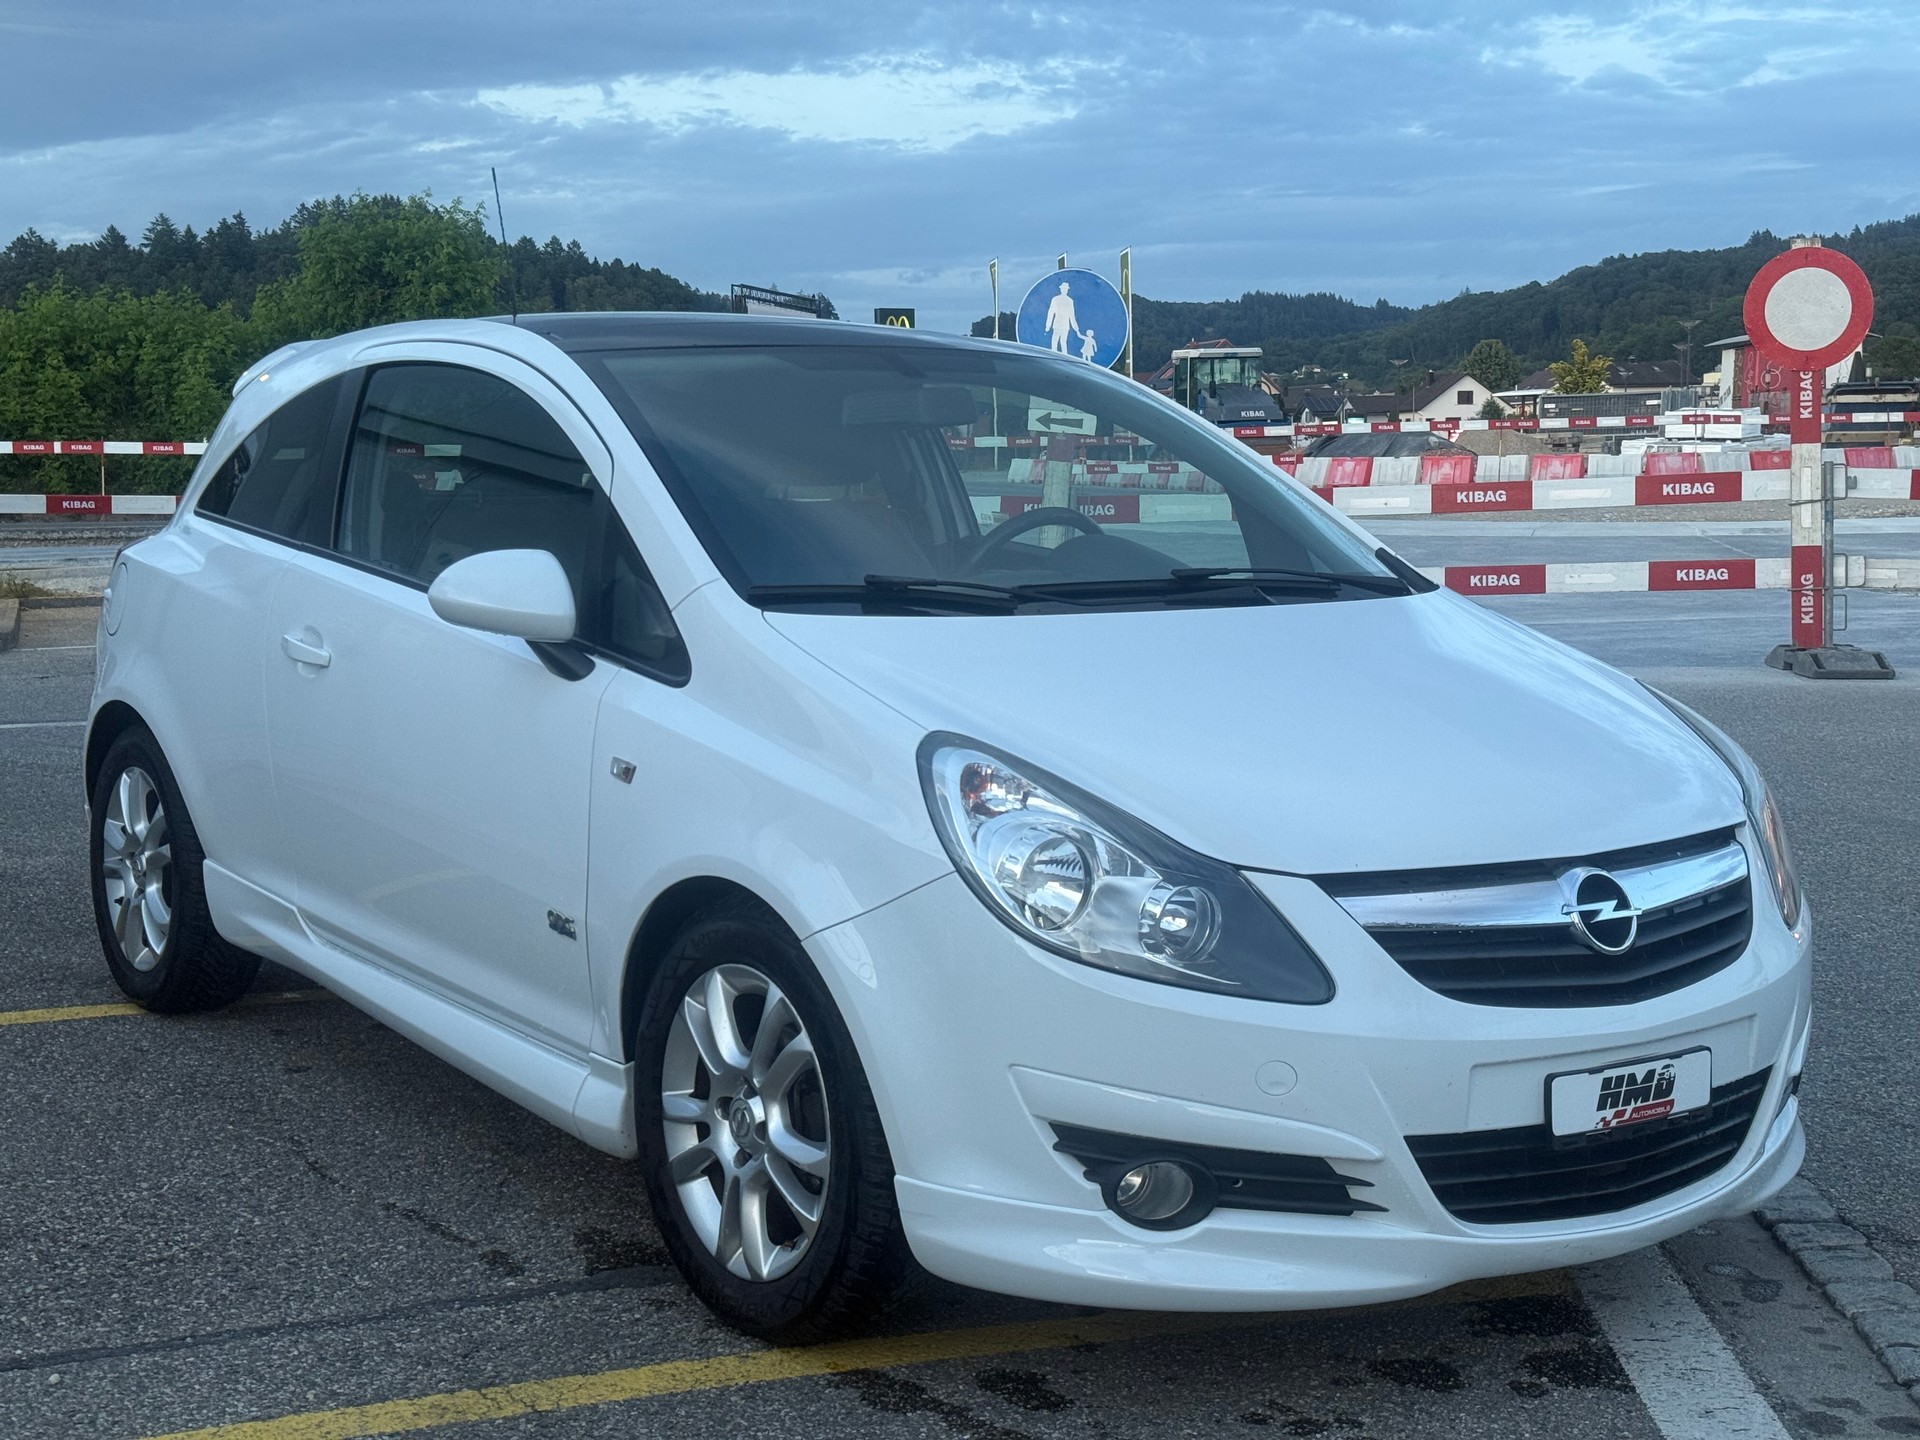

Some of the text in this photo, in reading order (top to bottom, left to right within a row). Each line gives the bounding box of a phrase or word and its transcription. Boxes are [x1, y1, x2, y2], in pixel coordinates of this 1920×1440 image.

[1799, 370, 1812, 418] KIBAG
[1241, 410, 1265, 418] KIBAG
[1662, 482, 1715, 496] KIBAG
[1456, 490, 1507, 504] KIBAG
[62, 500, 96, 510] KIBAG
[1470, 574, 1520, 587] KIBAG
[1677, 568, 1729, 581] KIBAG
[1800, 573, 1814, 624] KIBAG
